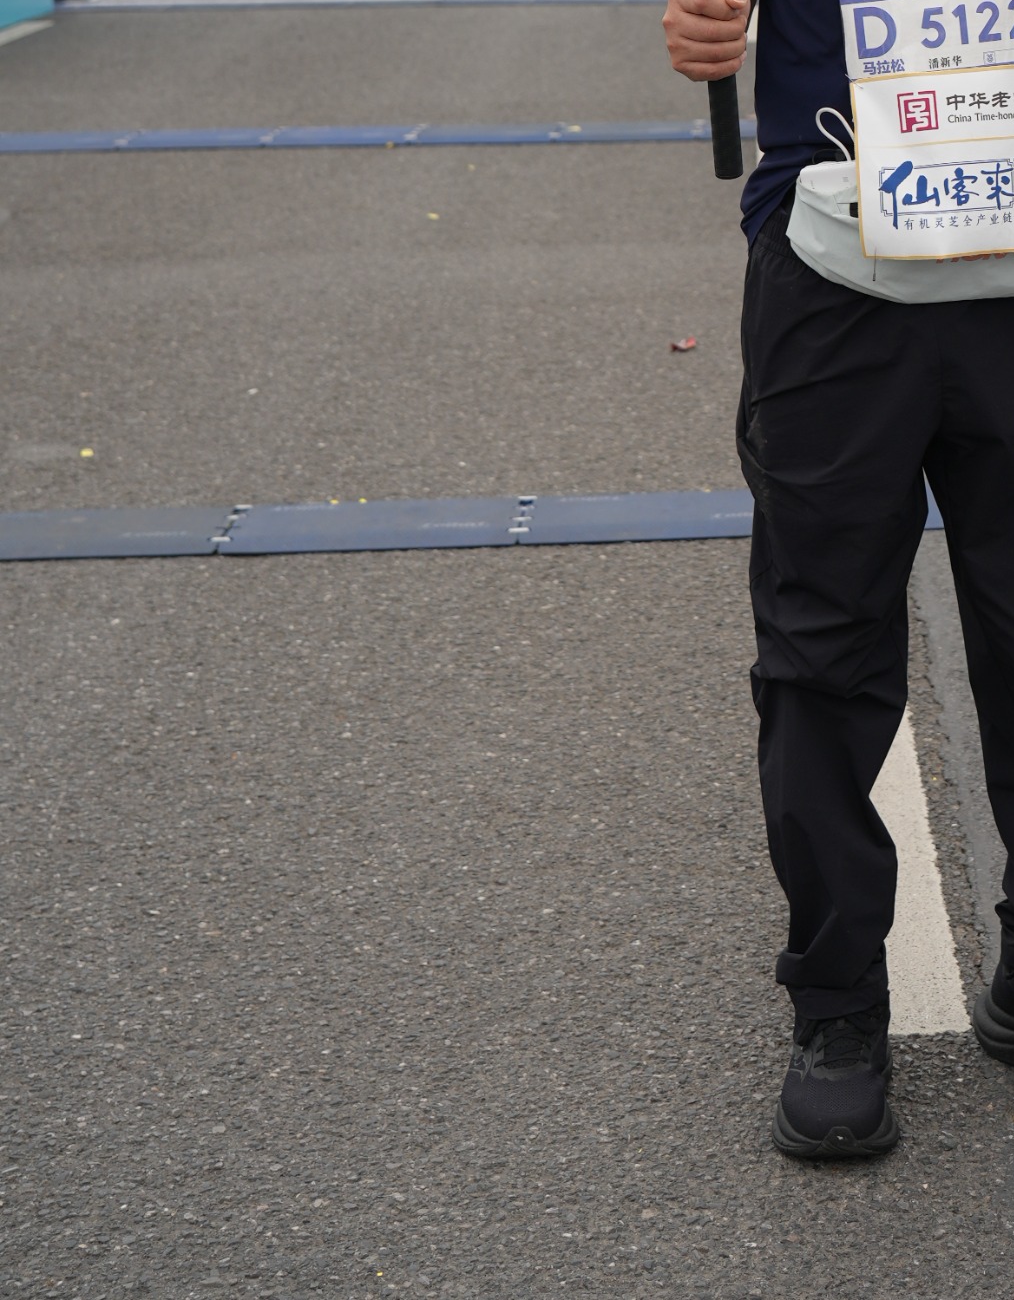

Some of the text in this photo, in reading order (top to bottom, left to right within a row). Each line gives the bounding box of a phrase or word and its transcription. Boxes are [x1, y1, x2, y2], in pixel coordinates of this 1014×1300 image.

[853, 6, 897, 60] D
[863, 55, 963, 76] 马拉松 潘新华
[947, 112, 972, 124] China
[879, 160, 1014, 230] 仙客来
[904, 211, 1013, 231] 有机灵芝全产业链
